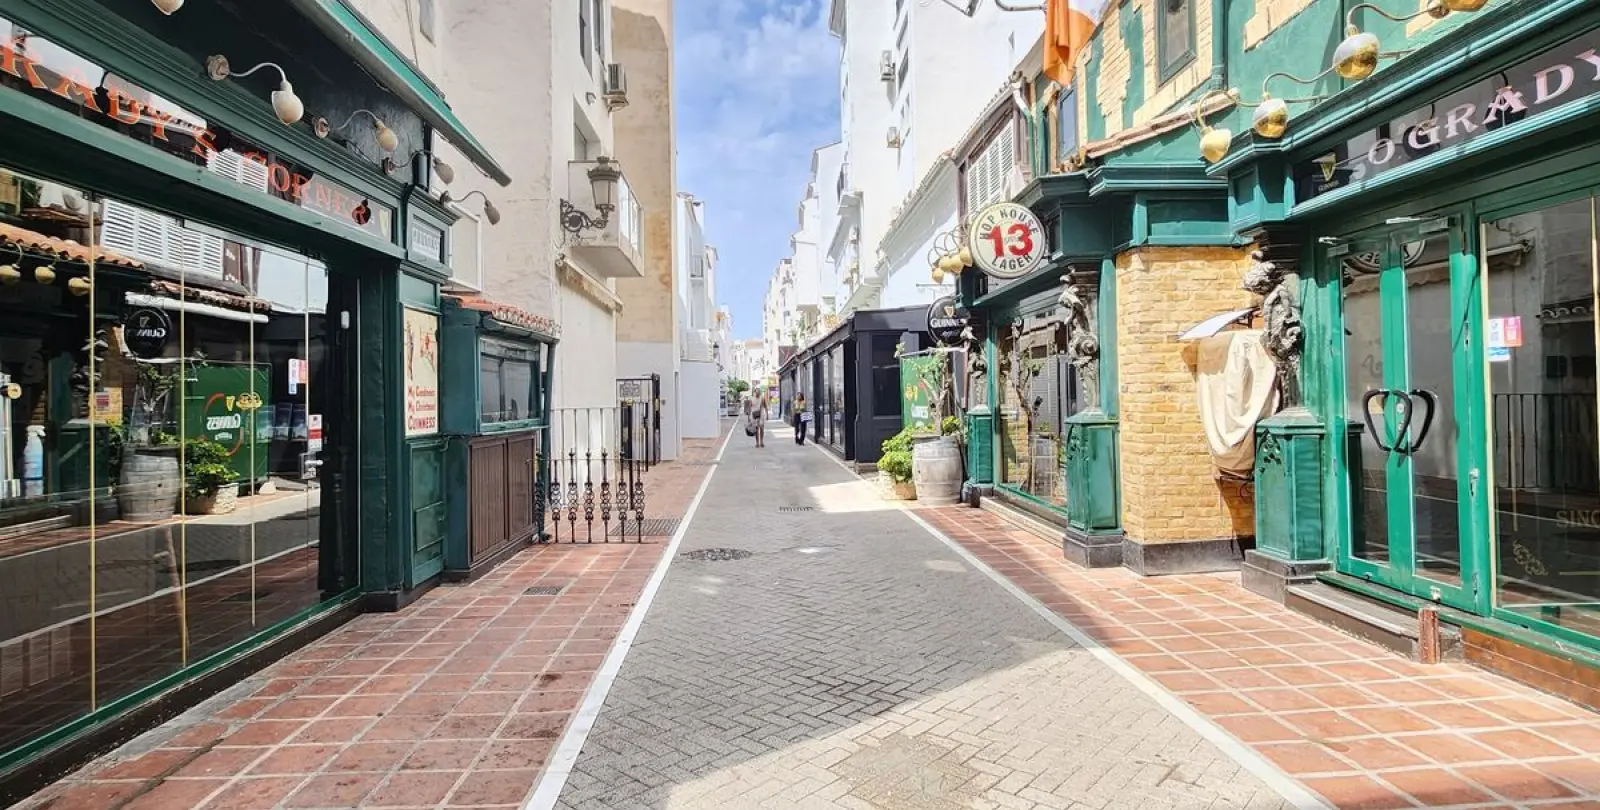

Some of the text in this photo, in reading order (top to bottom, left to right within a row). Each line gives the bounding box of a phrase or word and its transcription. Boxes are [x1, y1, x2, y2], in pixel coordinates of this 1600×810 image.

[979, 208, 1039, 240] HOP HOUSE
[990, 223, 1033, 257] 13
[991, 252, 1033, 270] LAGER
